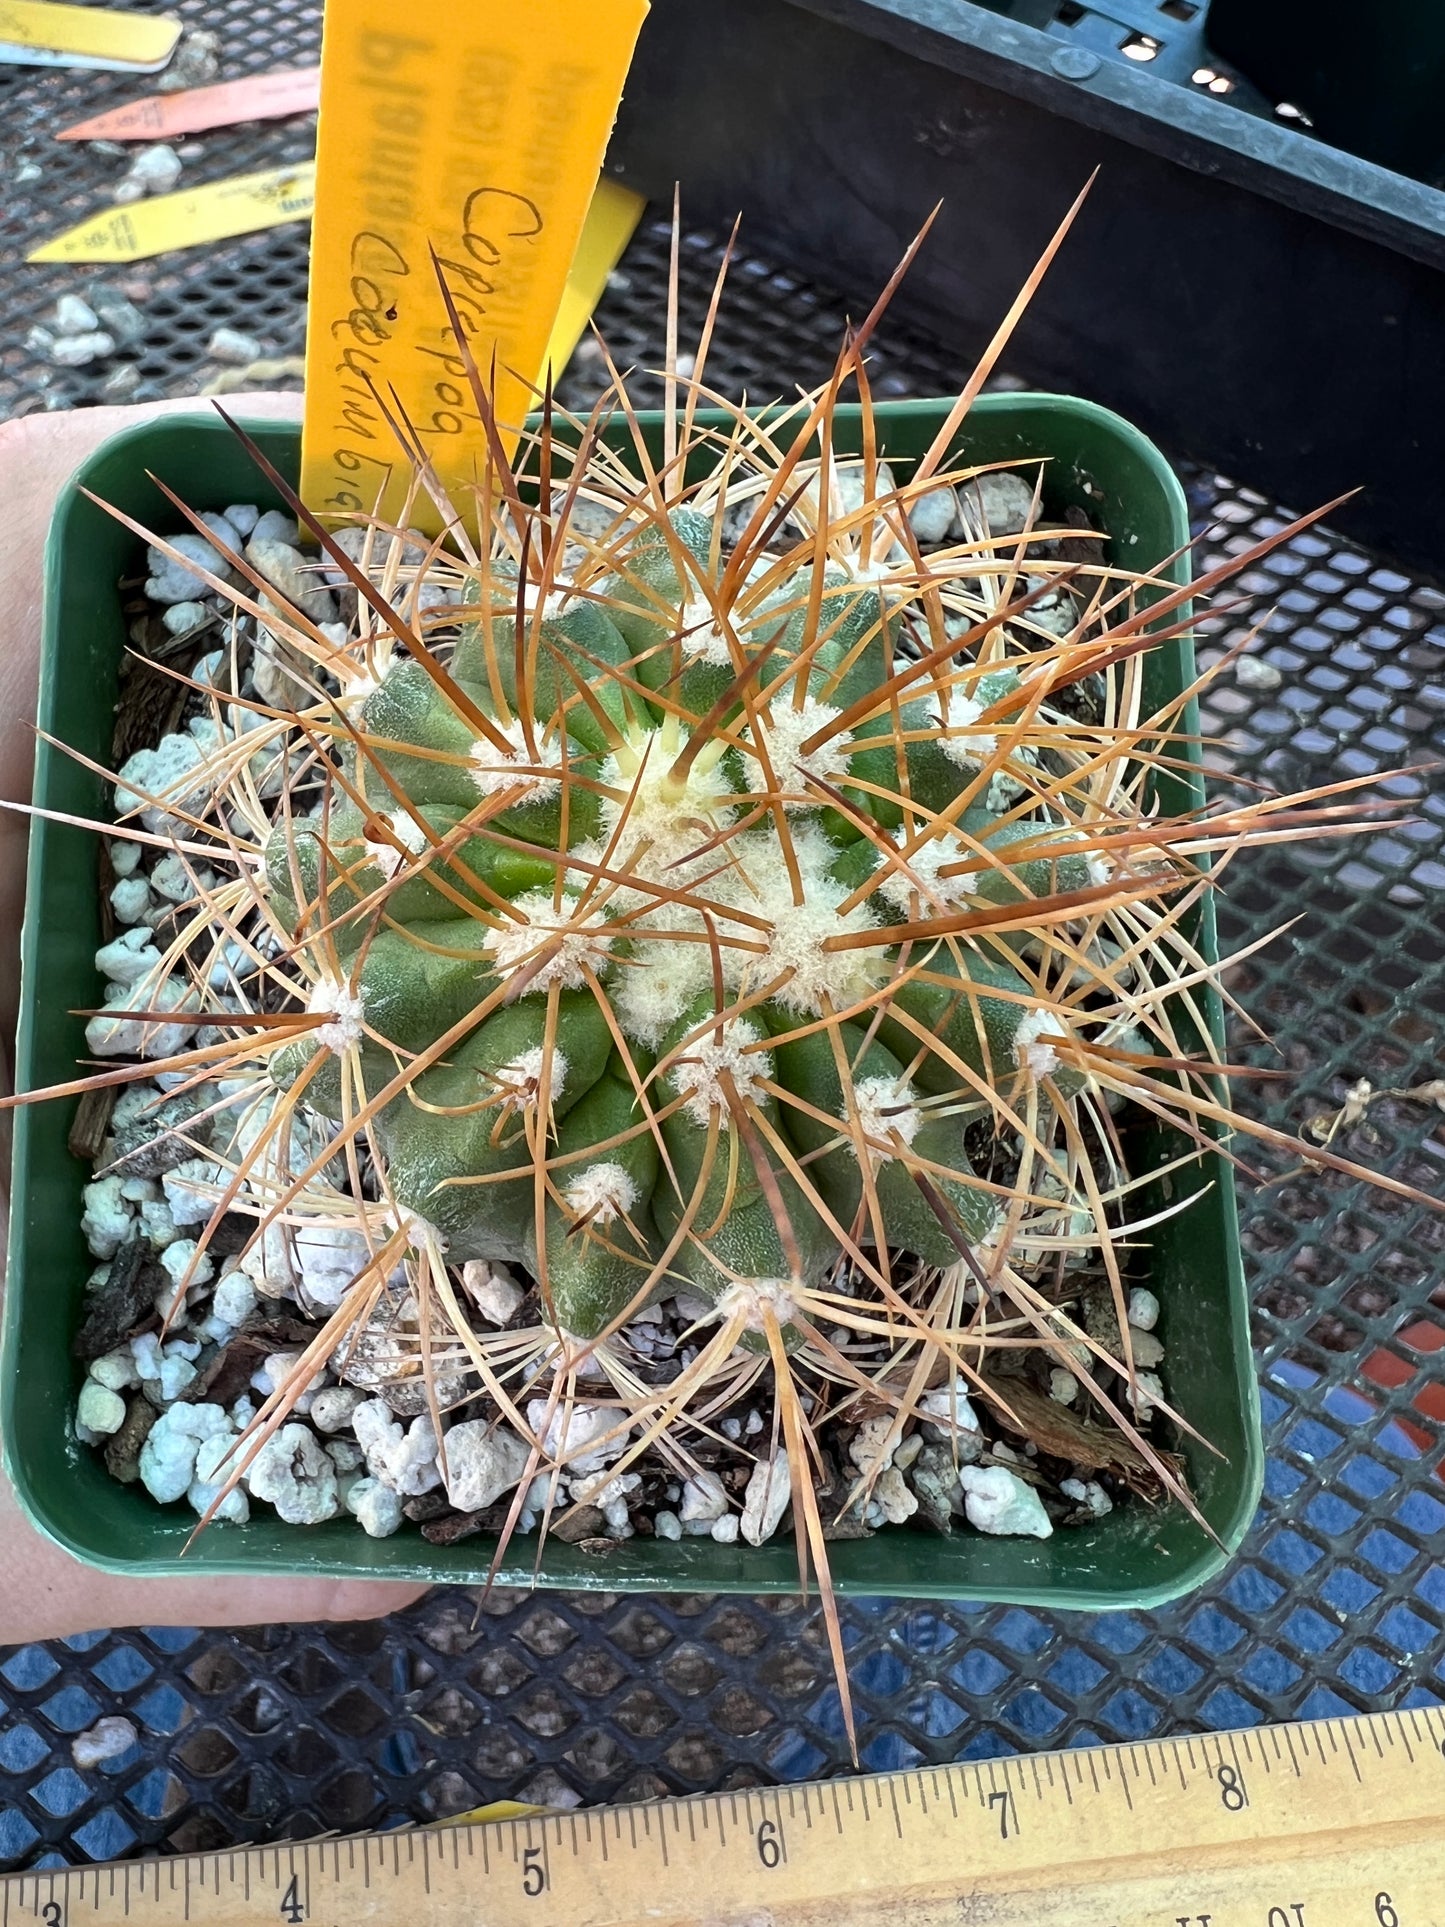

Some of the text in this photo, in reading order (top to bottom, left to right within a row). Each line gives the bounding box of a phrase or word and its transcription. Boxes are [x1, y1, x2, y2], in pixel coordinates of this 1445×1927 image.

[280, 1874, 304, 1923] 4
[523, 1847, 547, 1897] 5
[757, 1820, 780, 1869] 6
[988, 1791, 1010, 1839] 7
[1220, 1765, 1245, 1811] 8
